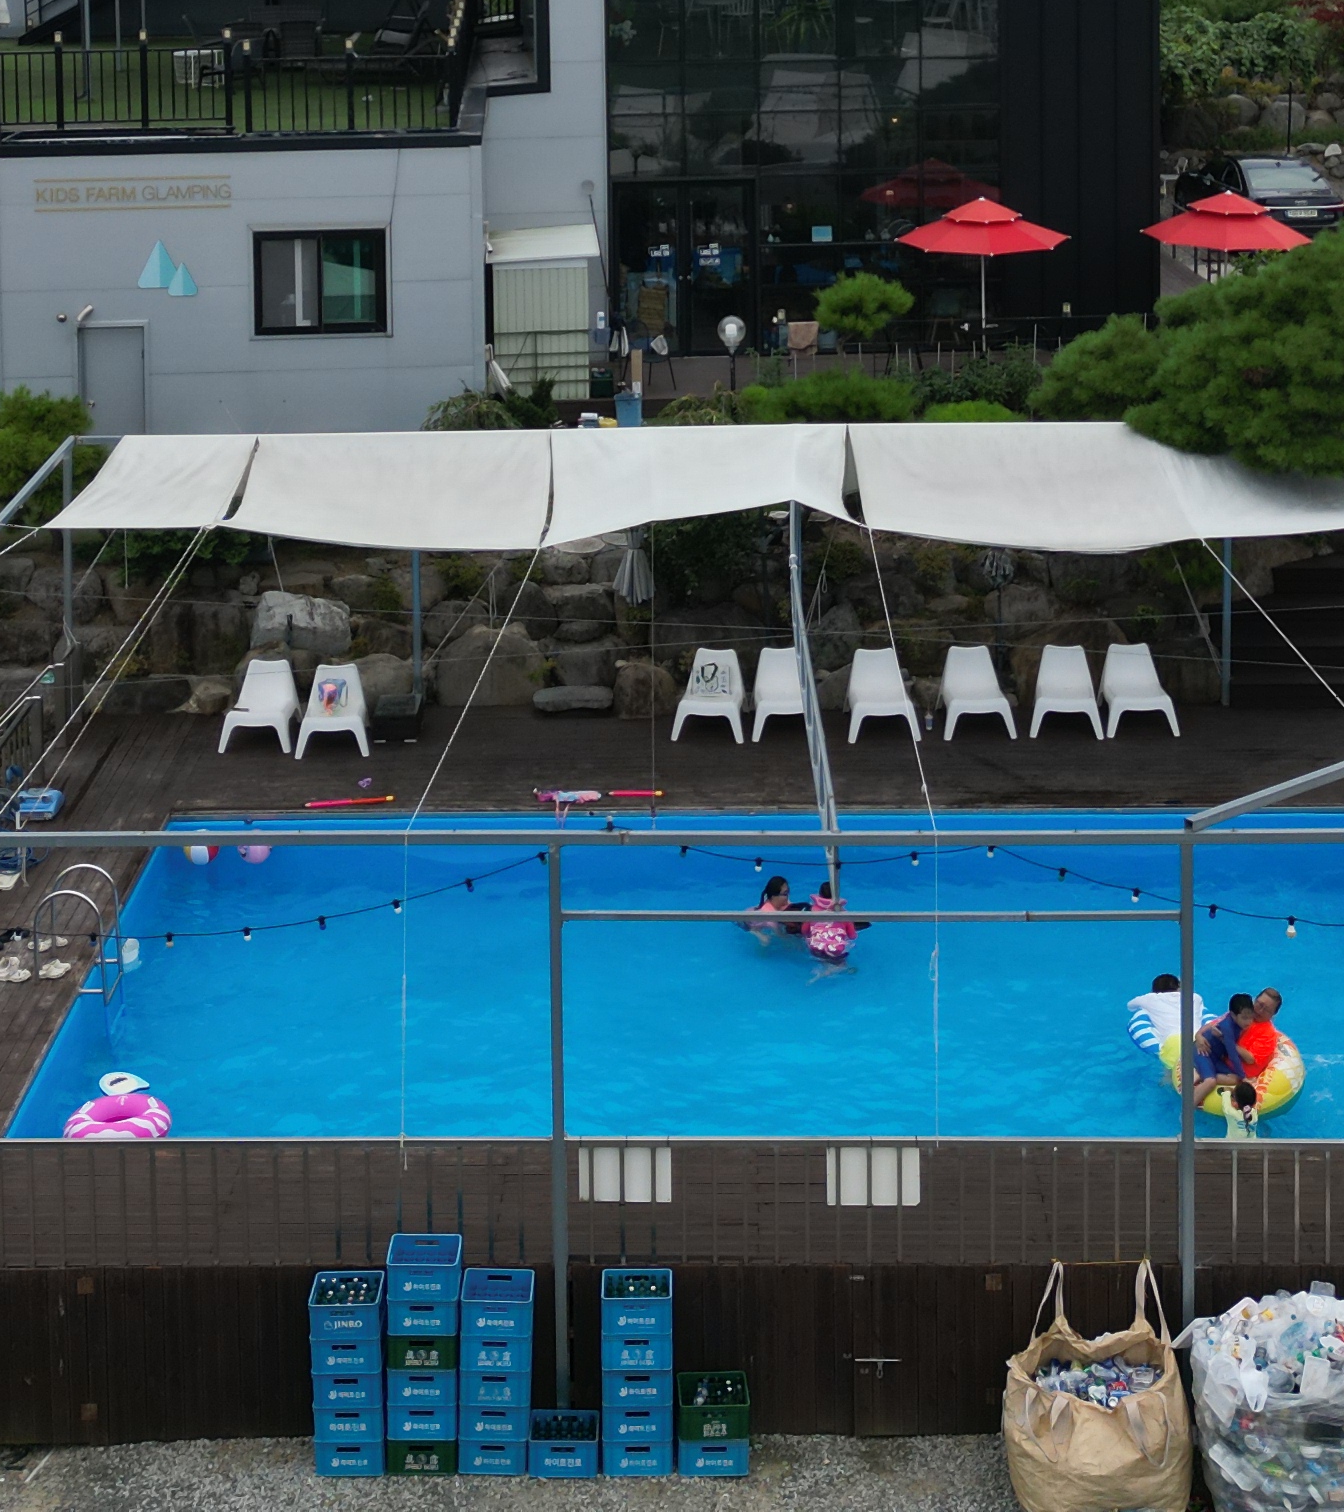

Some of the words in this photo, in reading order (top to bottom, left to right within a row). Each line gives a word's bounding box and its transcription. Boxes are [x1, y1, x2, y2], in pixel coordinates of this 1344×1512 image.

[35, 187, 79, 203] KIDS
[86, 186, 136, 202] FARM
[142, 184, 232, 201] GLAMPING
